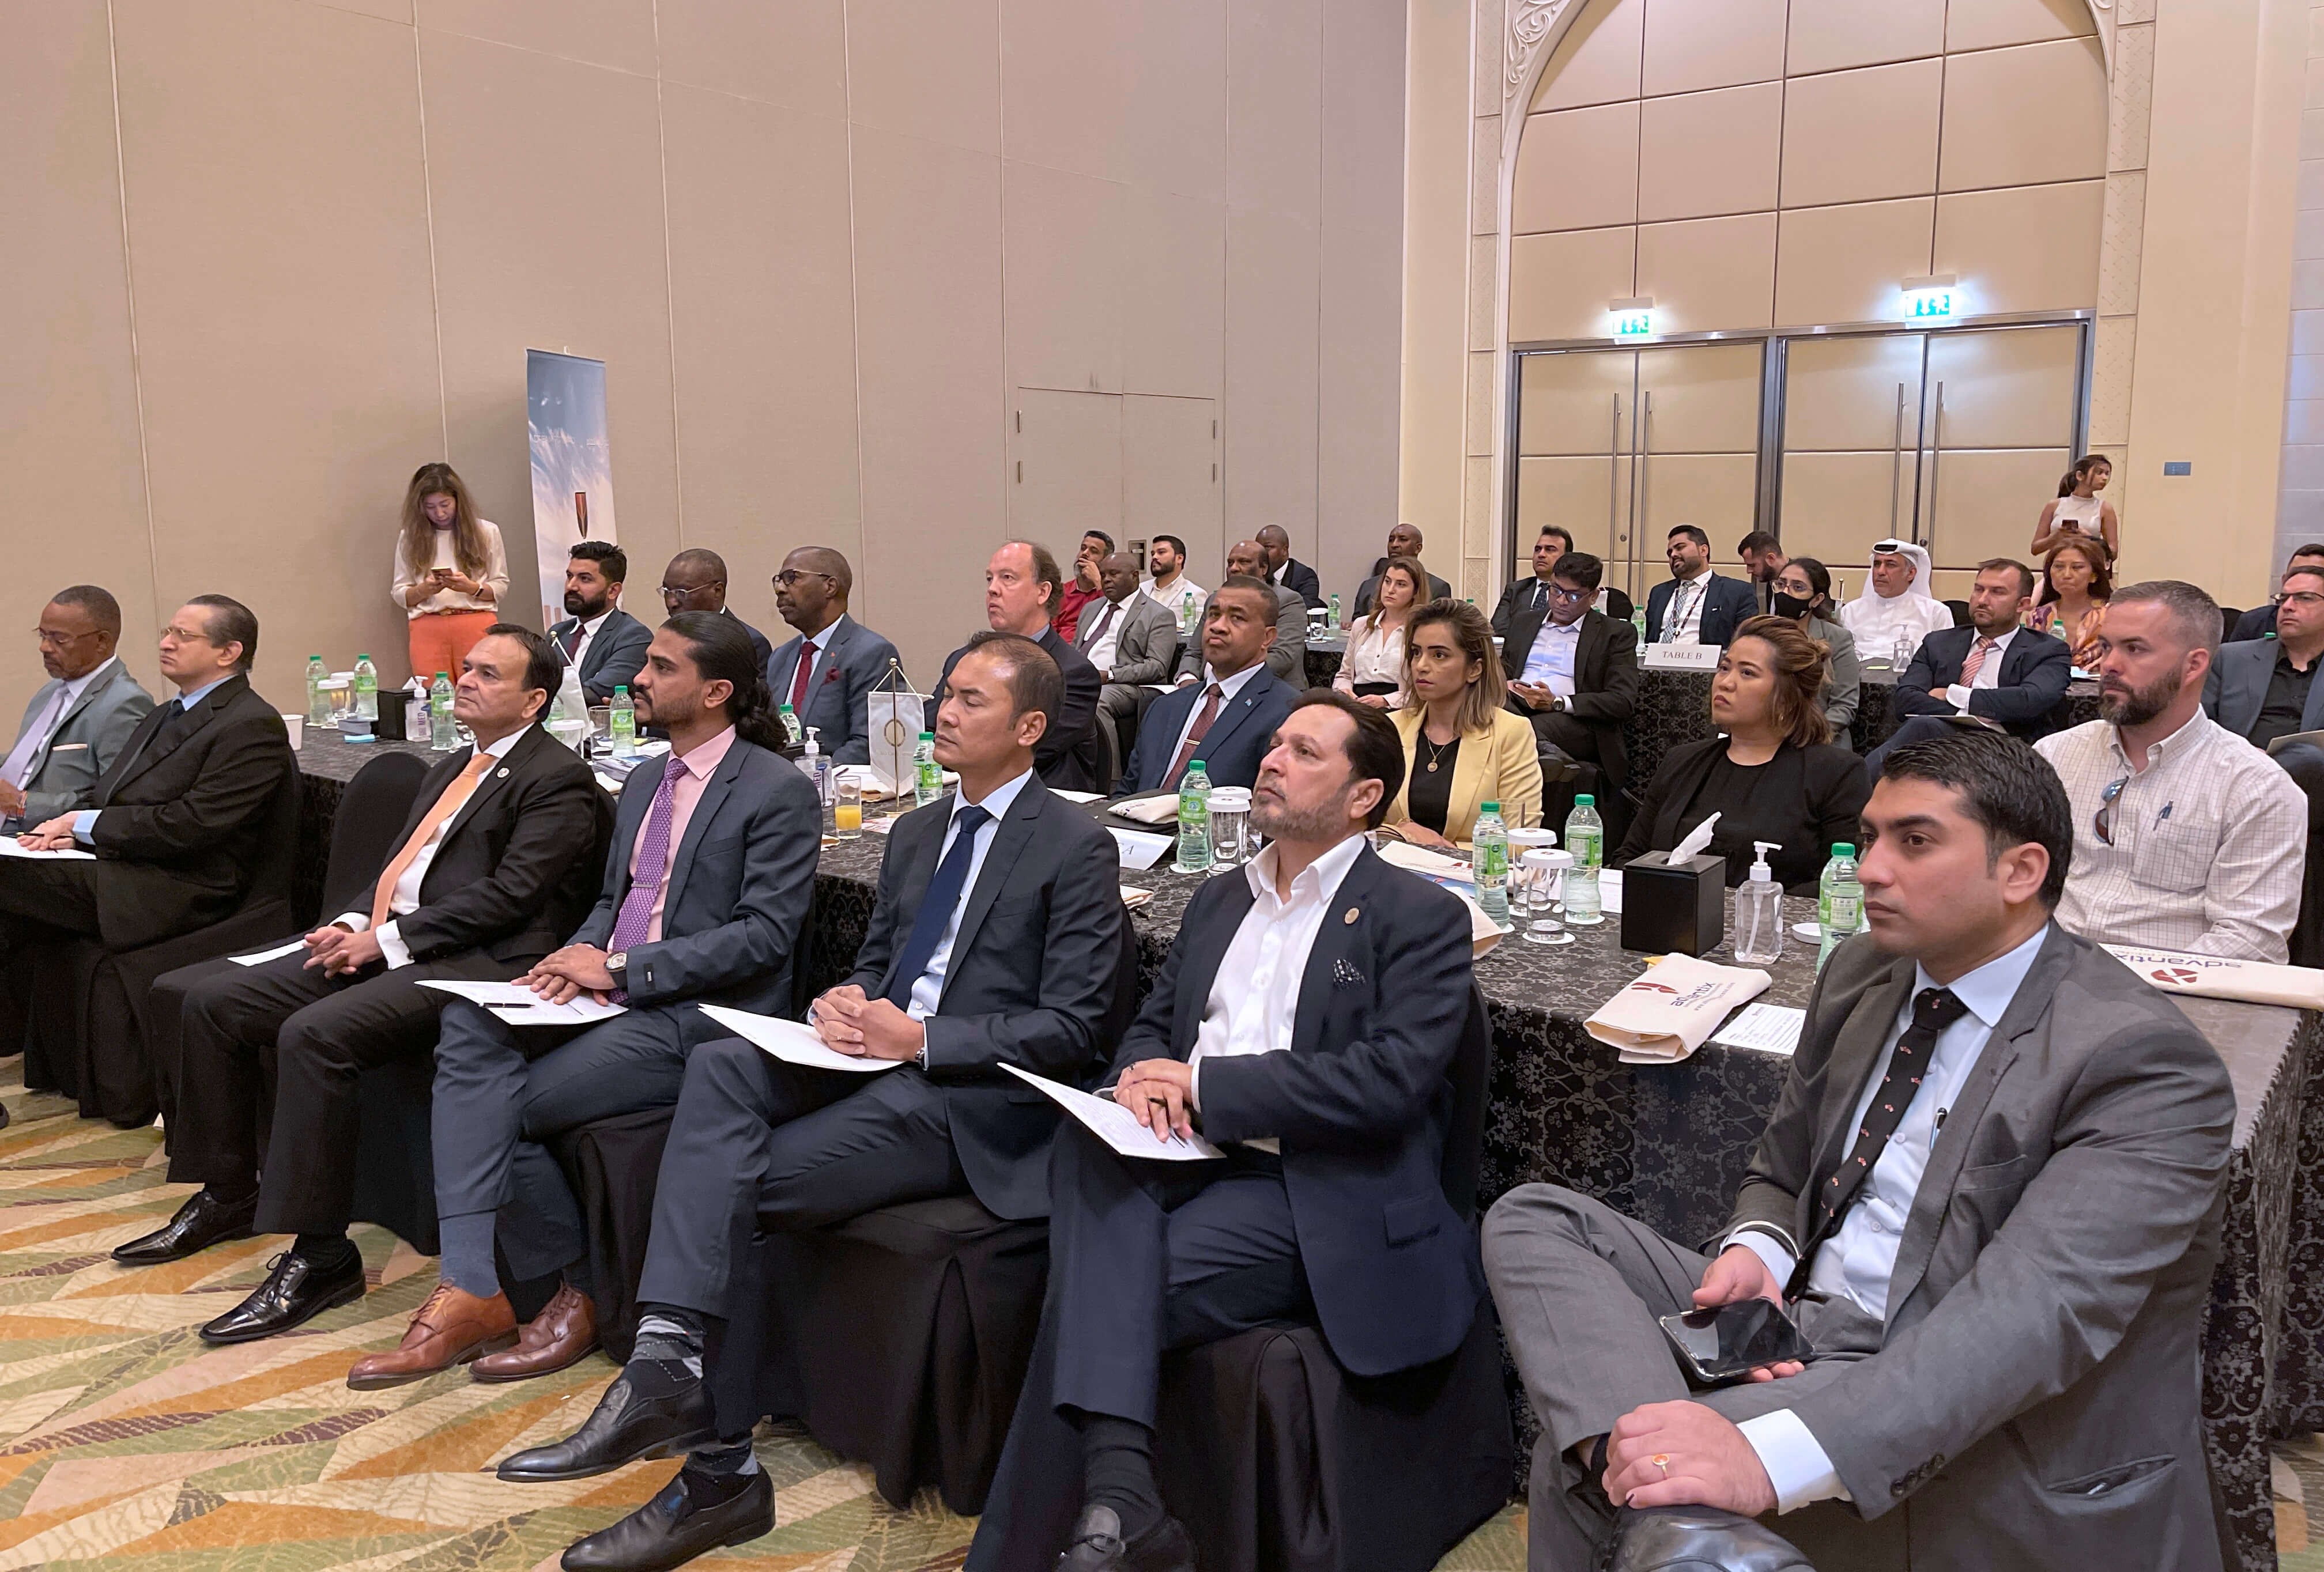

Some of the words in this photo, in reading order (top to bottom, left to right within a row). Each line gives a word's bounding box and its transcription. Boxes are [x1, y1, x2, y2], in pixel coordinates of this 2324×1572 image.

[1662, 651, 1693, 660] TABLE
[1695, 652, 1702, 660] B
[2115, 953, 2242, 969] advantix
[1670, 982, 1716, 1007] adantix
